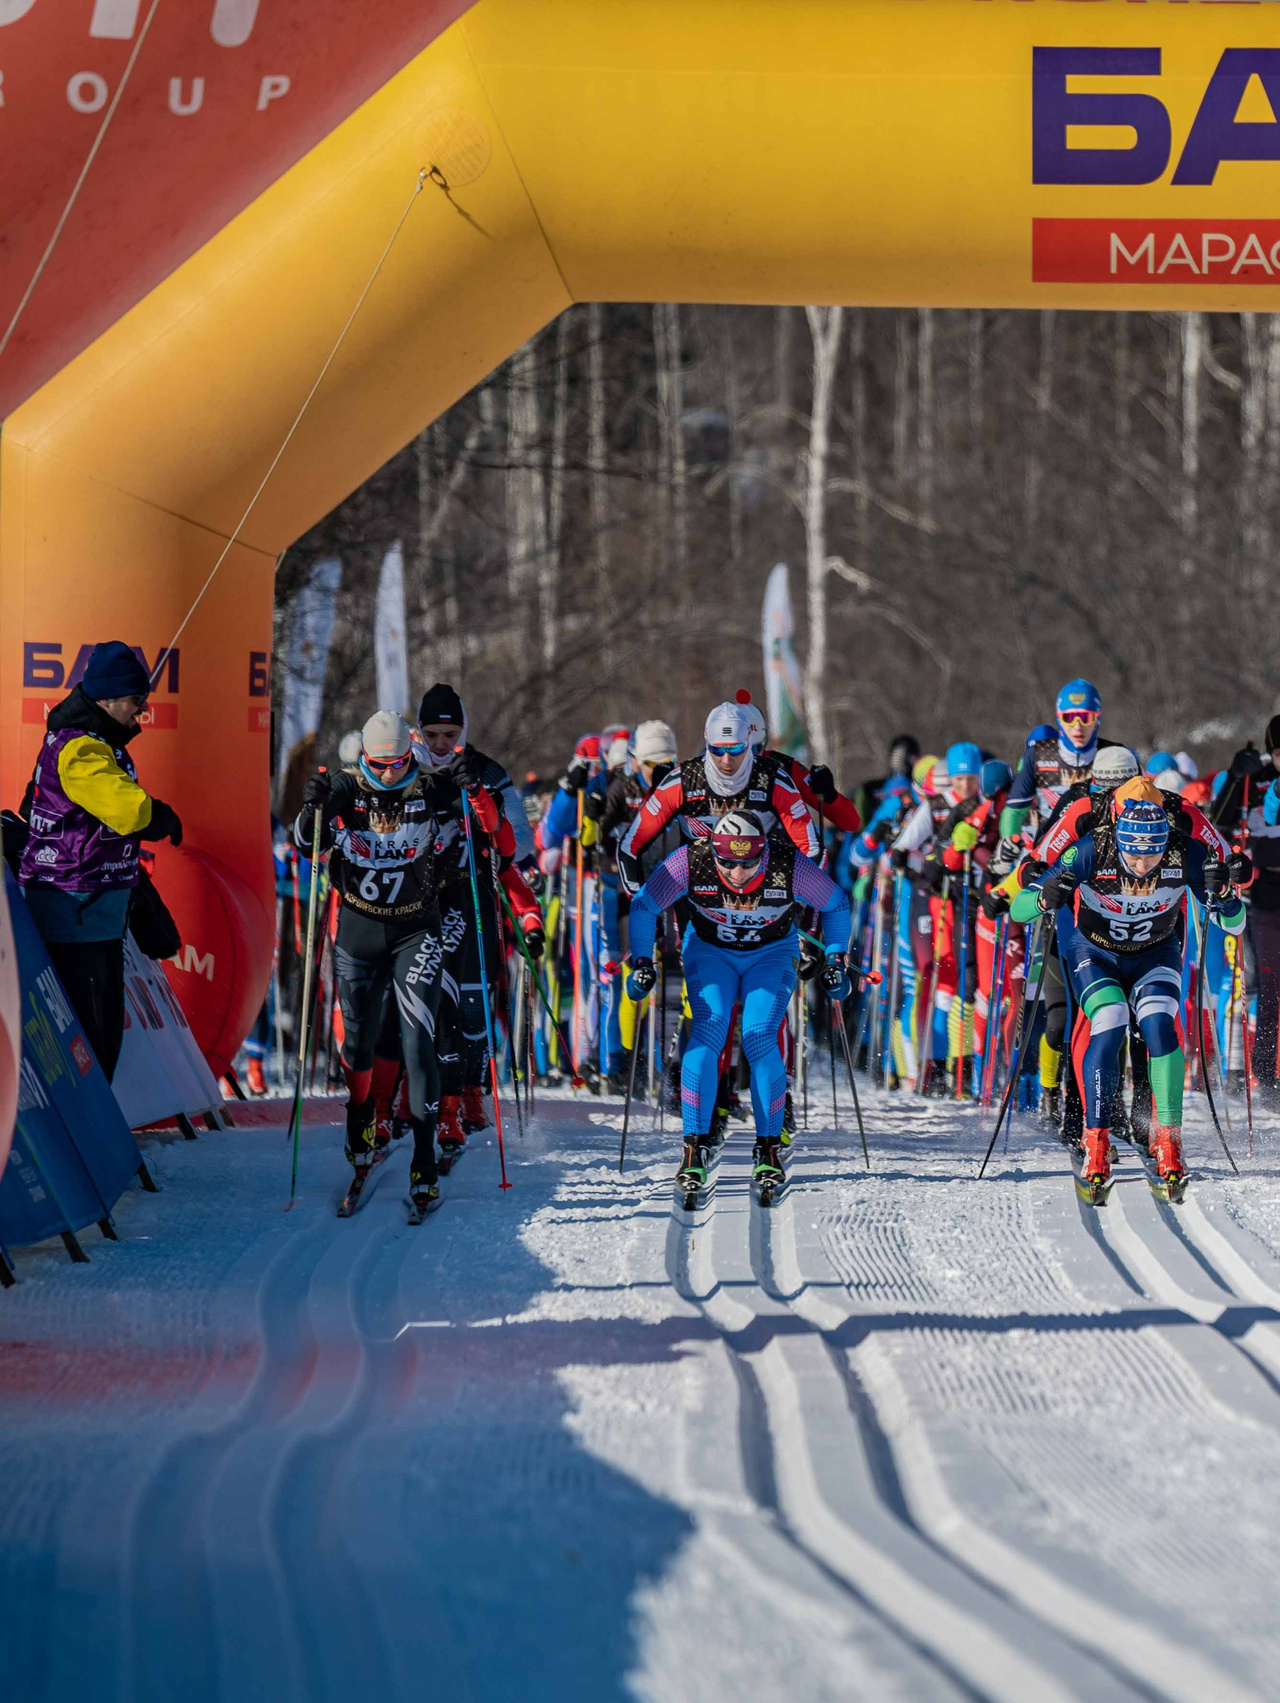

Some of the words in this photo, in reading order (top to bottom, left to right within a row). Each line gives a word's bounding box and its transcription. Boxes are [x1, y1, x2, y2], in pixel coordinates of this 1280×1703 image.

[0, 70, 290, 117] OUP
[375, 838, 419, 849] KRAS
[344, 892, 393, 916] КОРОЛЕВСКИЕ
[360, 870, 405, 904] 67
[441, 907, 462, 941] ACK
[1109, 920, 1154, 942] 52
[405, 933, 438, 985] BLACK
[420, 944, 444, 985] LYNX
